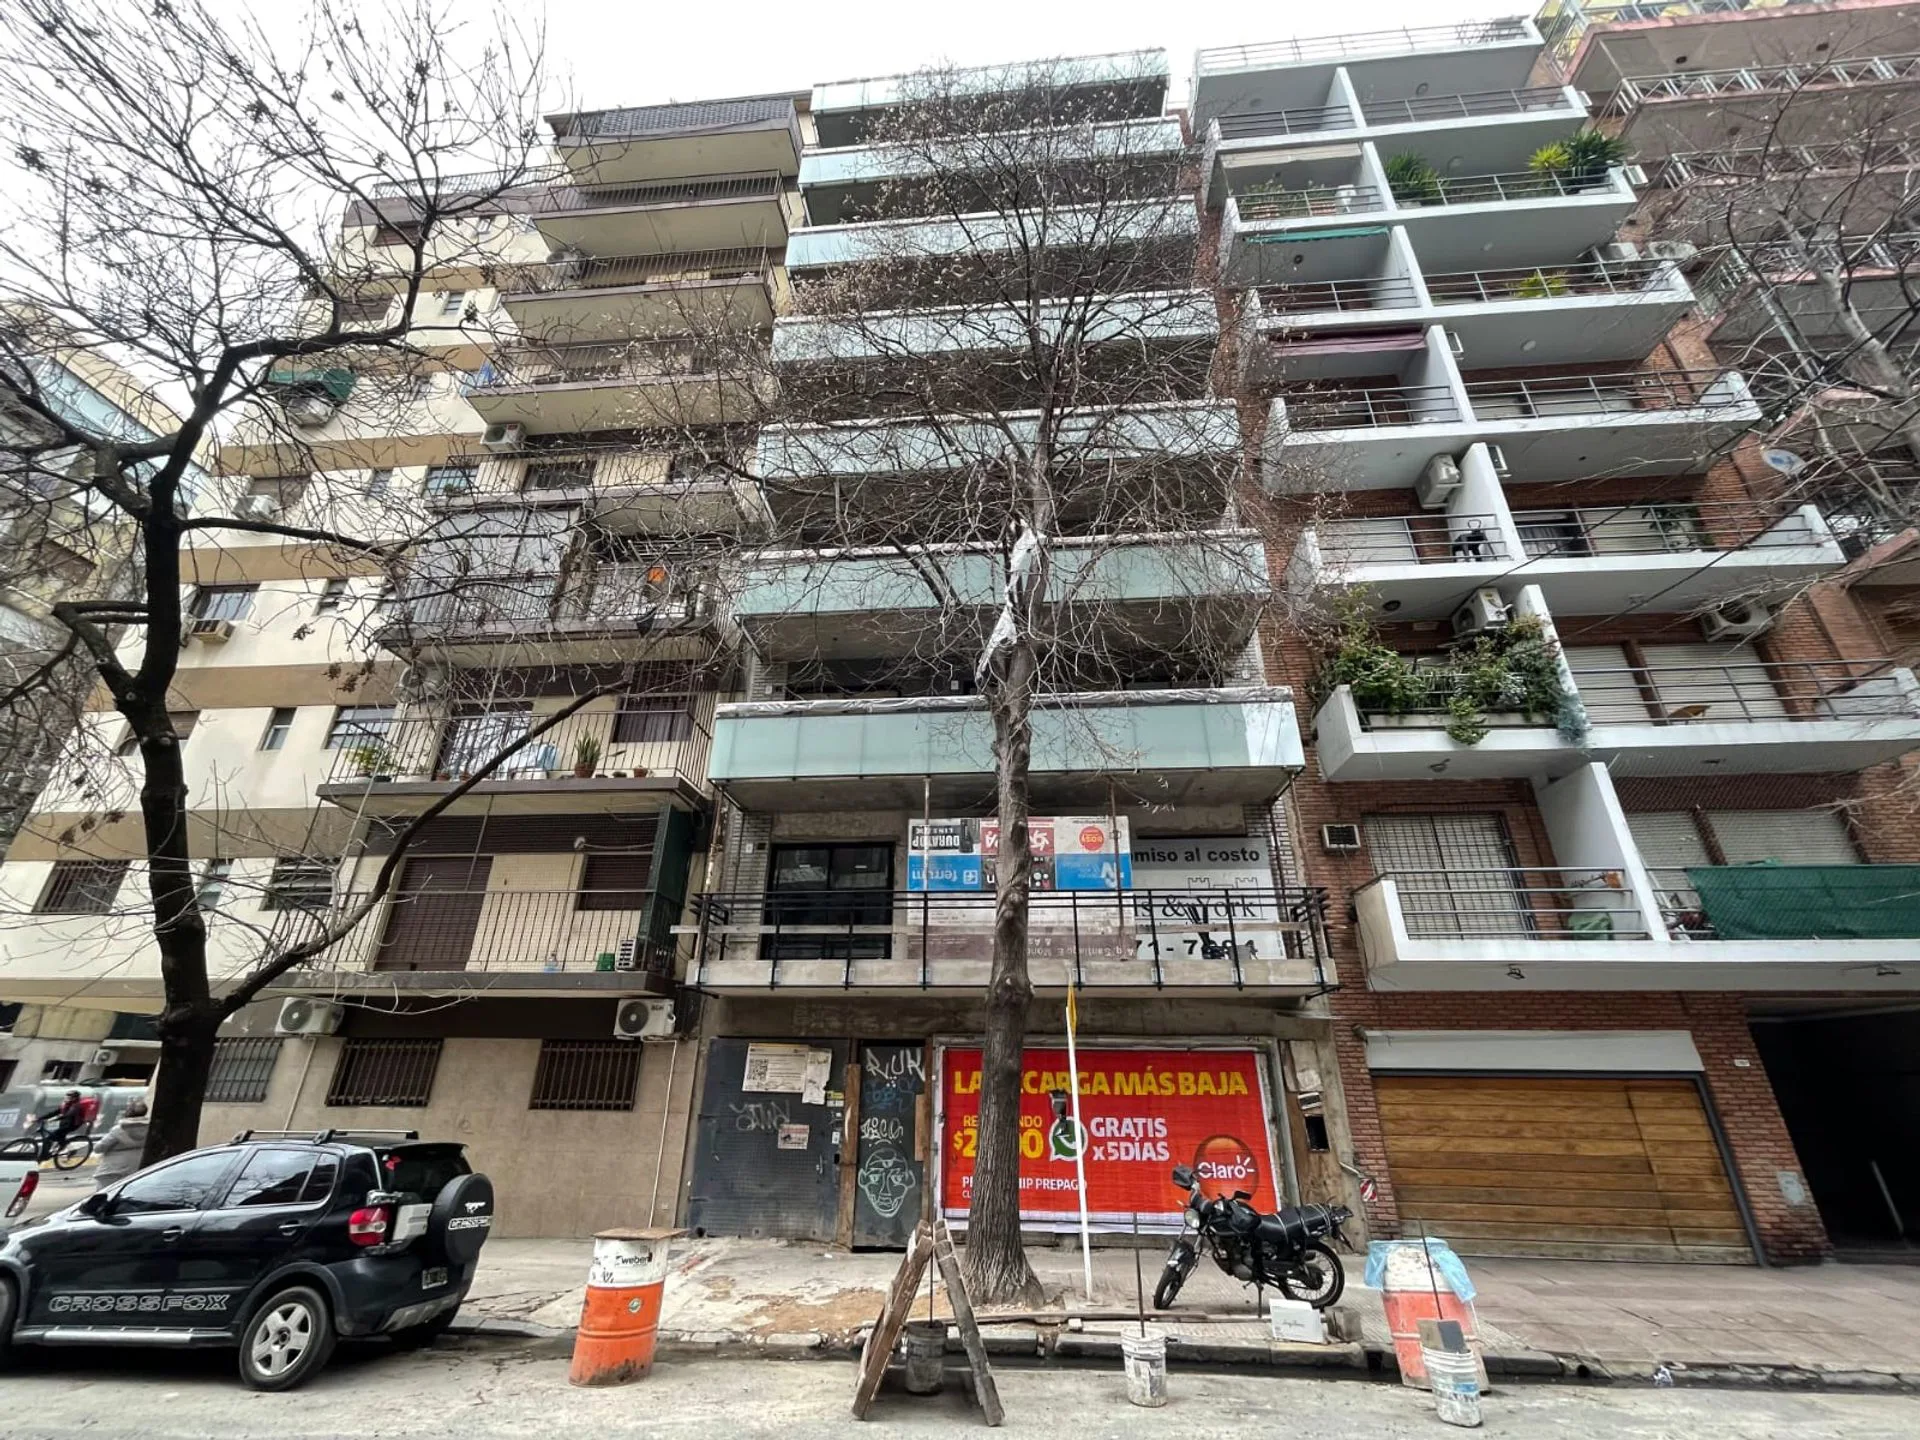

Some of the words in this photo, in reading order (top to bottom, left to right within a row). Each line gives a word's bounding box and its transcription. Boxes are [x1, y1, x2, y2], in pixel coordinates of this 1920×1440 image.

[1131, 848, 1179, 863] miso
[1184, 848, 1201, 863] al
[1207, 848, 1261, 863] costo
[954, 1071, 983, 1094] LA
[1020, 1071, 1111, 1096] CARGA
[1113, 1066, 1176, 1096] MÁS
[1179, 1071, 1249, 1096] BAJA
[1089, 1117, 1168, 1138] GRATIS
[1198, 1160, 1248, 1179] Claro
[1035, 1178, 1087, 1191] PREPAG
[49, 1294, 231, 1313] CROSSFOX
